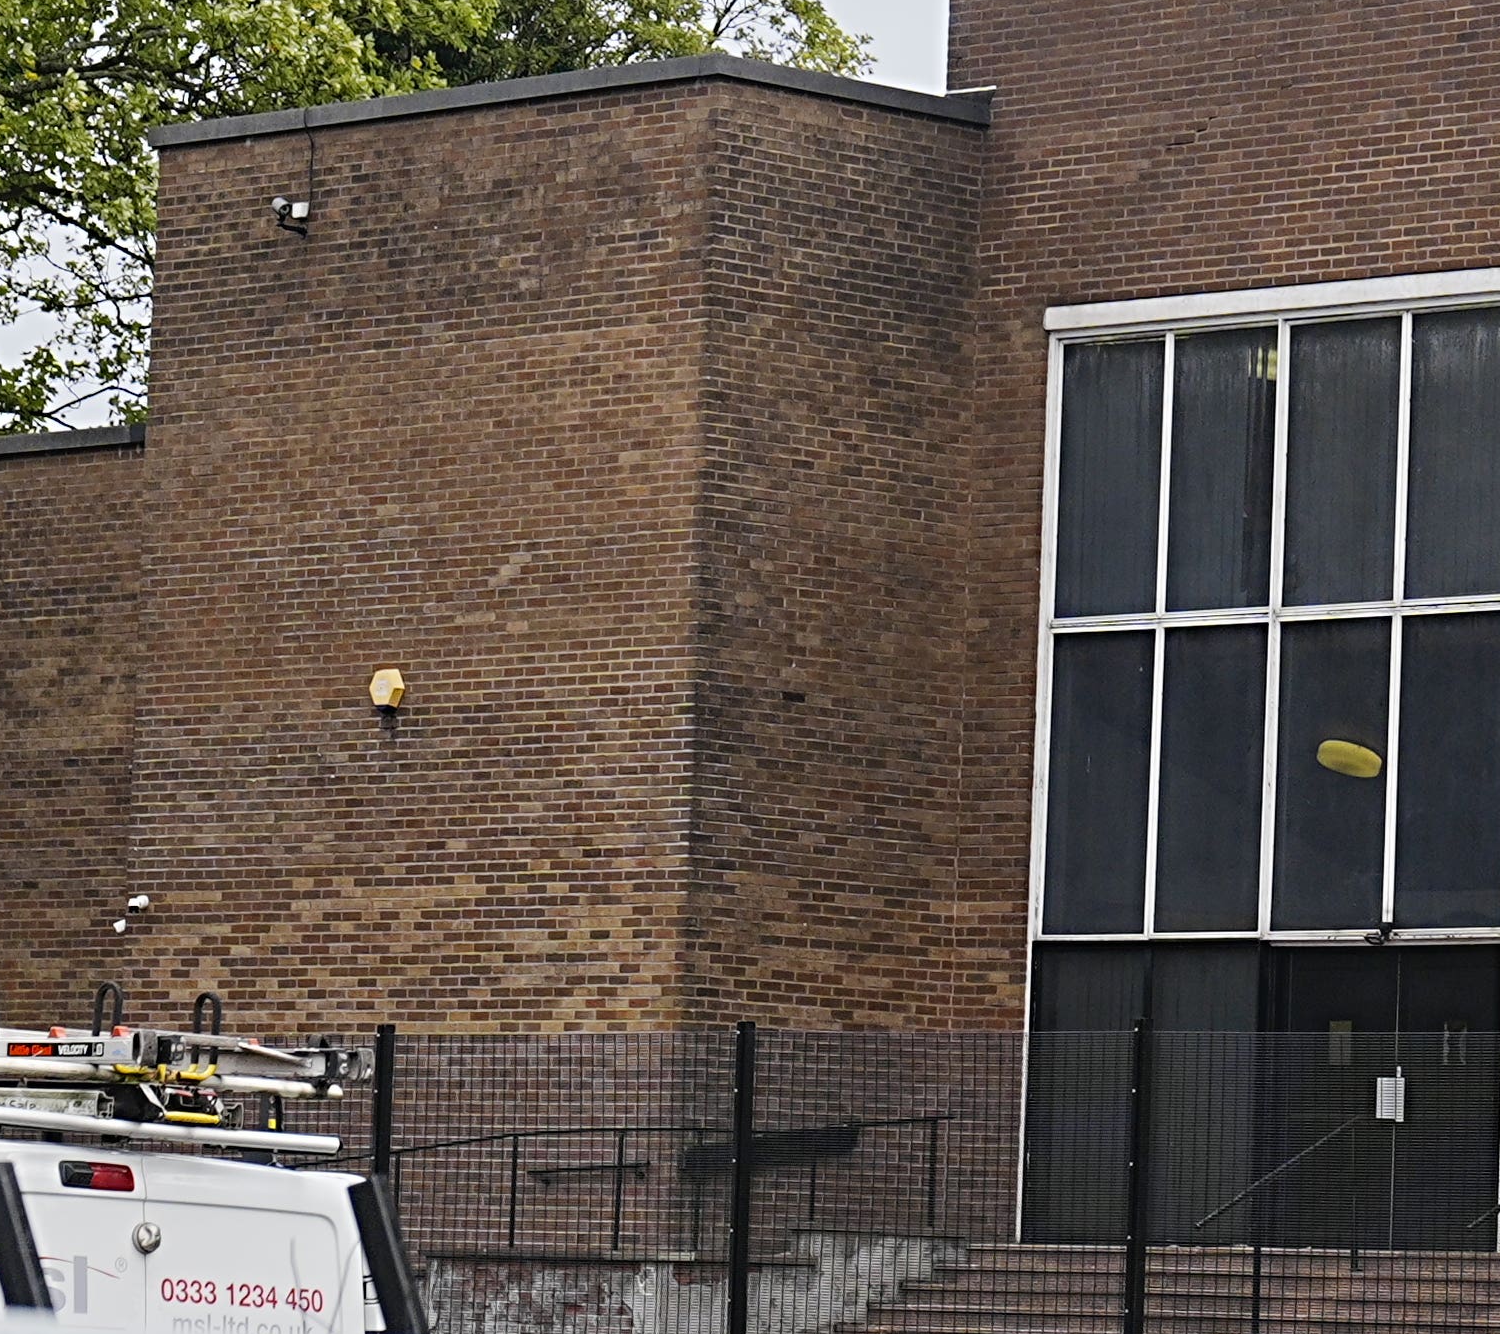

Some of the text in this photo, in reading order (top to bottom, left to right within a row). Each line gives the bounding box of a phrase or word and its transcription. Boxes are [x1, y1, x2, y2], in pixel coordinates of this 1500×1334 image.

[57, 1044, 89, 1056] VELOCITY
[161, 1279, 324, 1314] 0333 1234 450
